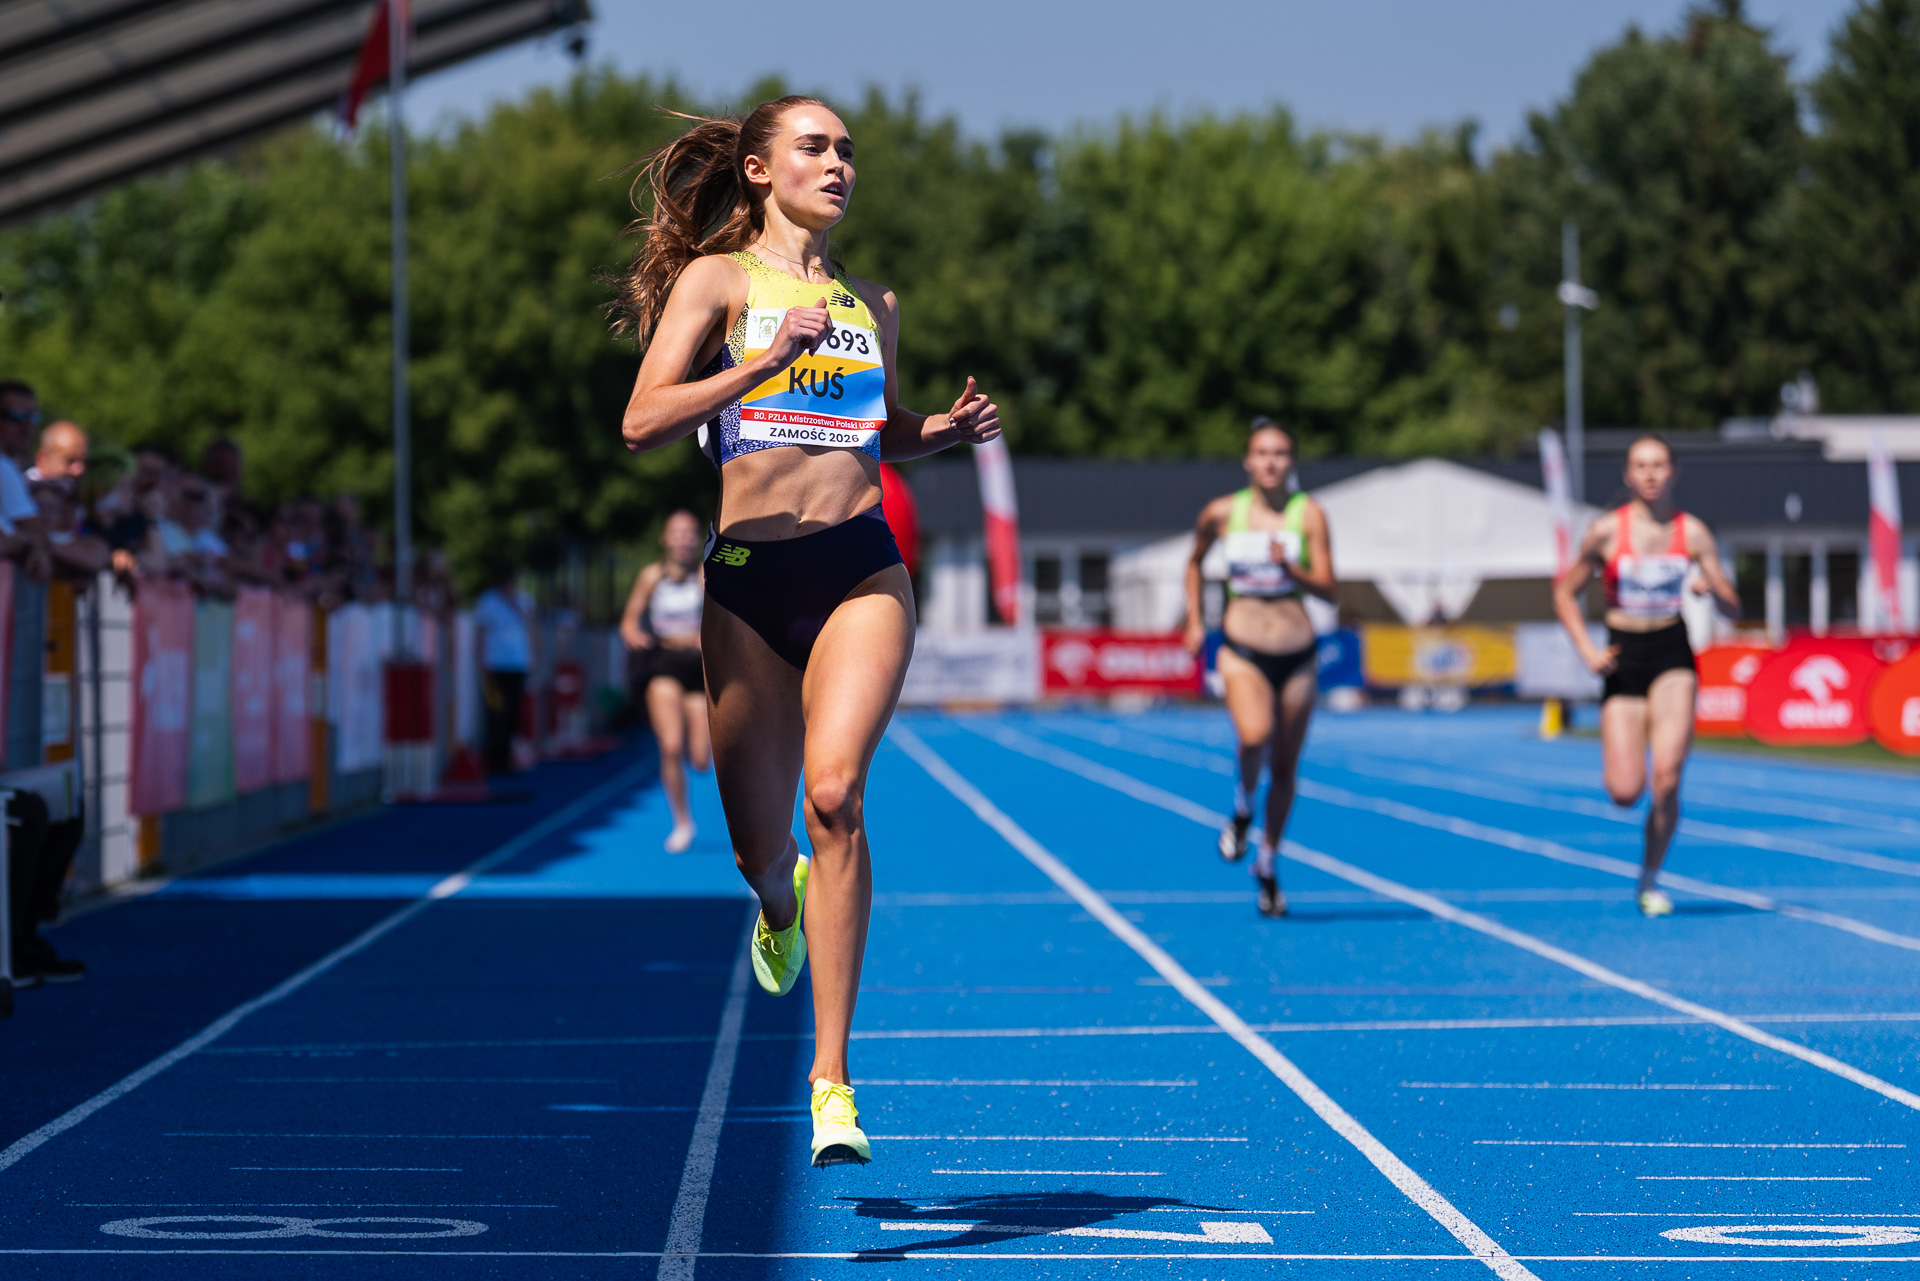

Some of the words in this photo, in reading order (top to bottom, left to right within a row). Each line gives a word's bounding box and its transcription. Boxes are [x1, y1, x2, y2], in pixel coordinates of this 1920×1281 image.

[788, 366, 845, 400] KUŚ
[753, 411, 767, 421] 80.
[768, 412, 788, 422] PZLA
[789, 415, 835, 427] Mistrzostwa
[835, 420, 858, 429] Polski
[858, 421, 876, 429] U20
[769, 427, 827, 441] ZAMOŚĆ
[829, 432, 860, 443] 2026
[99, 1215, 490, 1240] 8
[879, 1221, 1274, 1244] 7
